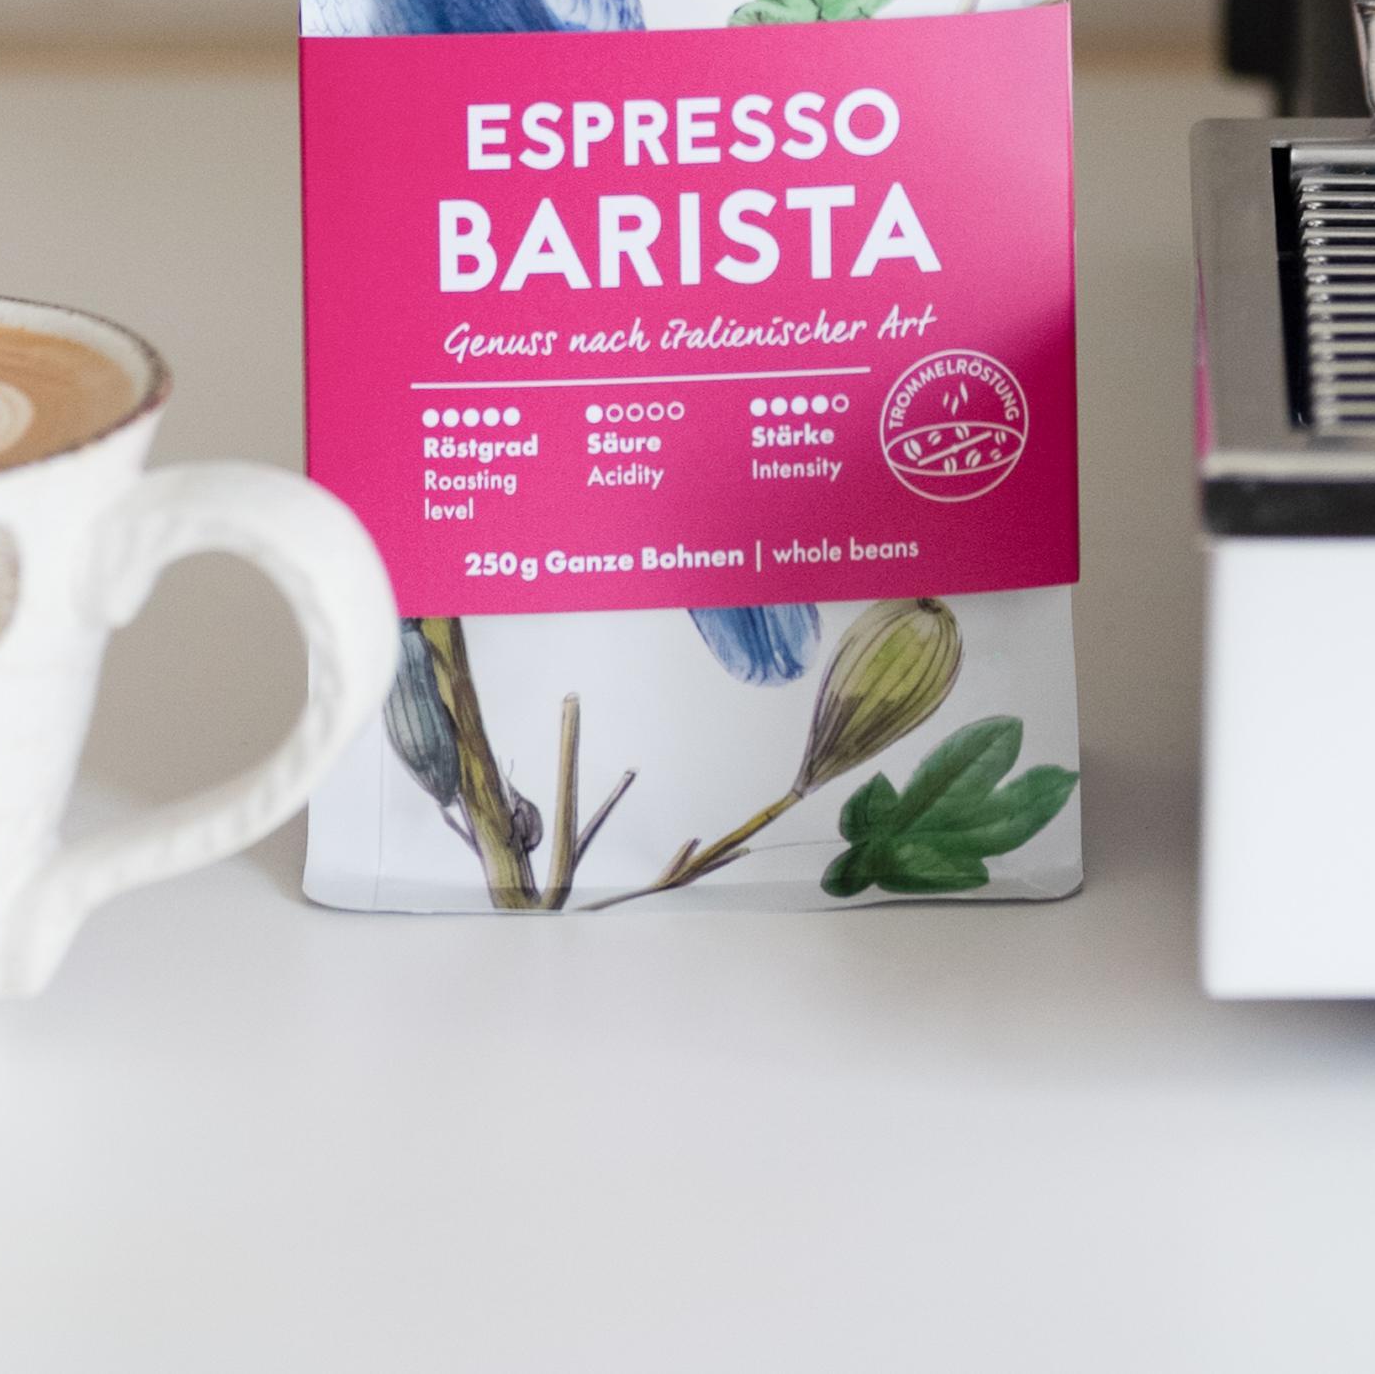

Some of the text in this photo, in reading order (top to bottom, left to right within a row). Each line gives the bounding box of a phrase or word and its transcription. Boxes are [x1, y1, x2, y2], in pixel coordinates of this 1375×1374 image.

[467, 87, 901, 171] ESPRESSO
[438, 181, 942, 293] BARISTA
[443, 303, 937, 364] Genuss nach italienischer Art
[888, 358, 1020, 430] TROMMELRÖSTUNG
[423, 433, 539, 464] Röstgrad
[587, 431, 662, 455] Säure
[751, 422, 835, 448] Stärke
[424, 469, 518, 496] Roasting
[587, 462, 664, 490] Acidity
[752, 456, 843, 482] Intensity
[424, 497, 474, 521] level
[544, 550, 635, 574] Ganze
[641, 543, 744, 571] Bohnen
[772, 537, 842, 564] whole
[849, 536, 919, 561] beans
